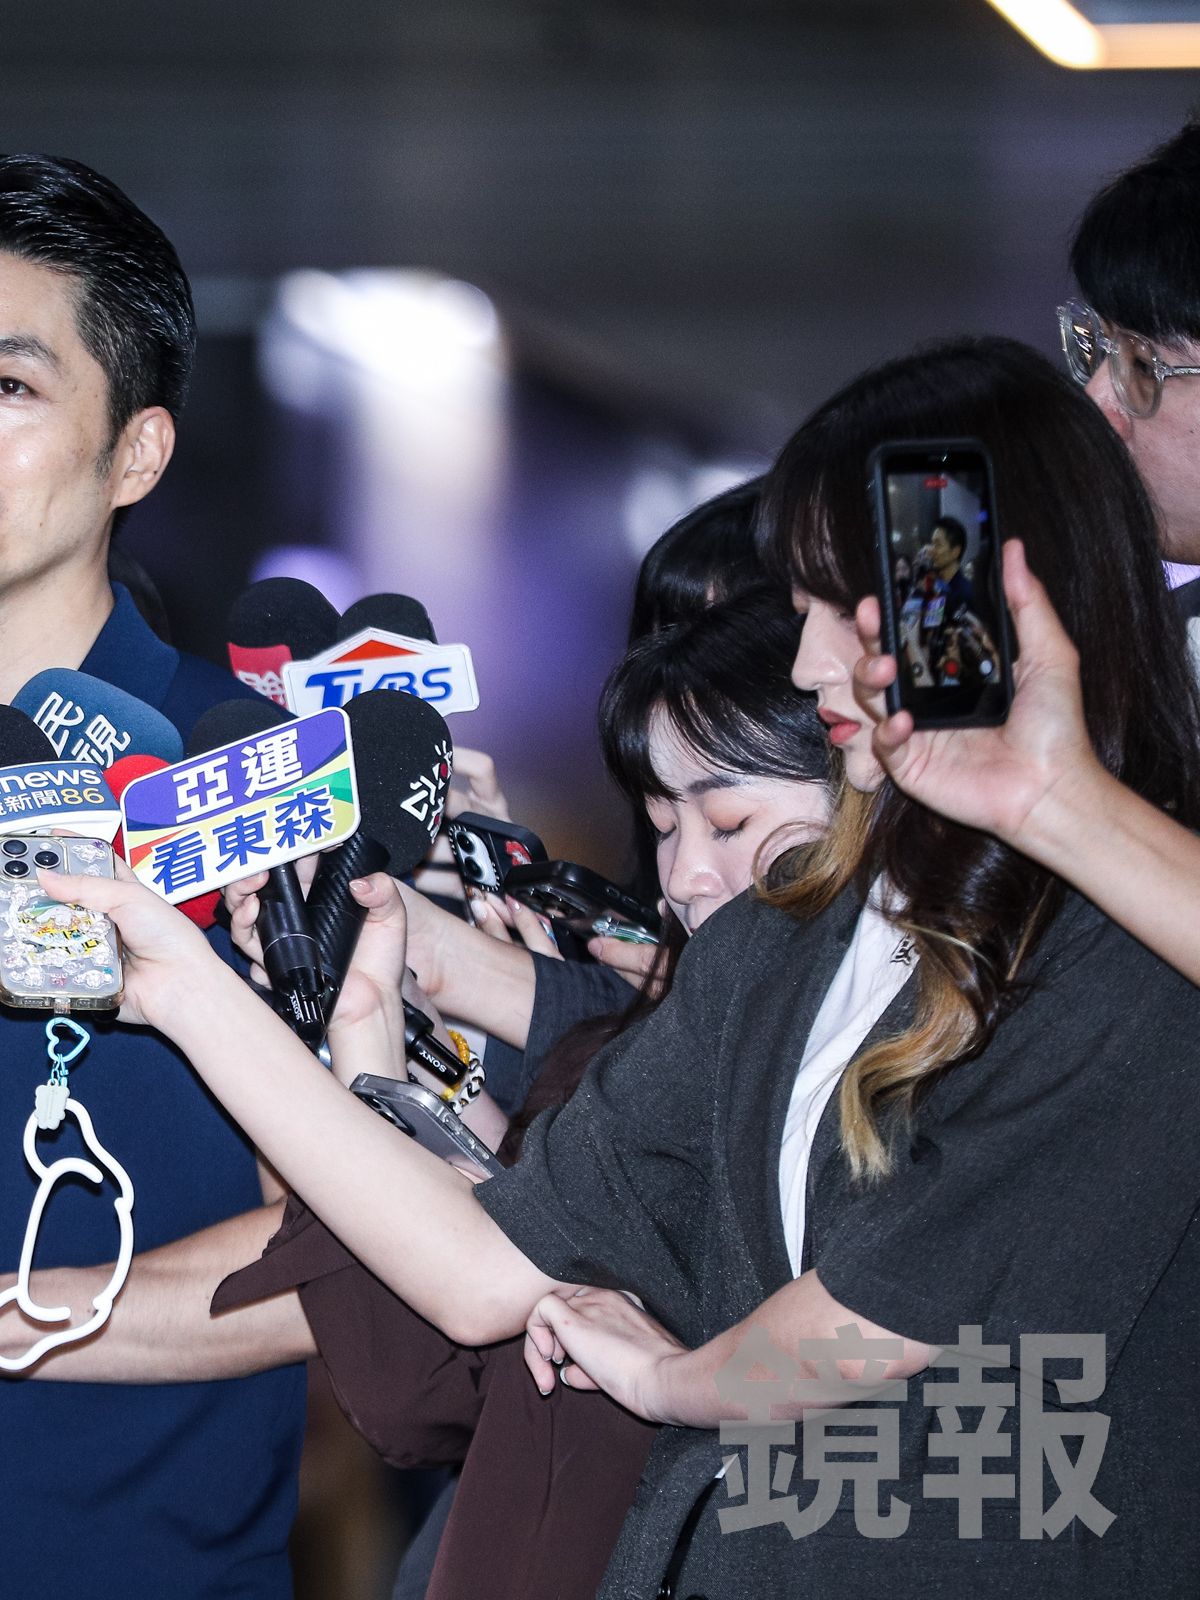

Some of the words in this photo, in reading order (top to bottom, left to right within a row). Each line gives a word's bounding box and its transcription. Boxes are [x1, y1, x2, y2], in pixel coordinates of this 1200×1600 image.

[34, 691, 132, 769] 民視
[171, 727, 303, 824] 亞運
[152, 786, 335, 895] 看東森
[289, 994, 302, 1021] SONY
[418, 1050, 448, 1074] SONY
